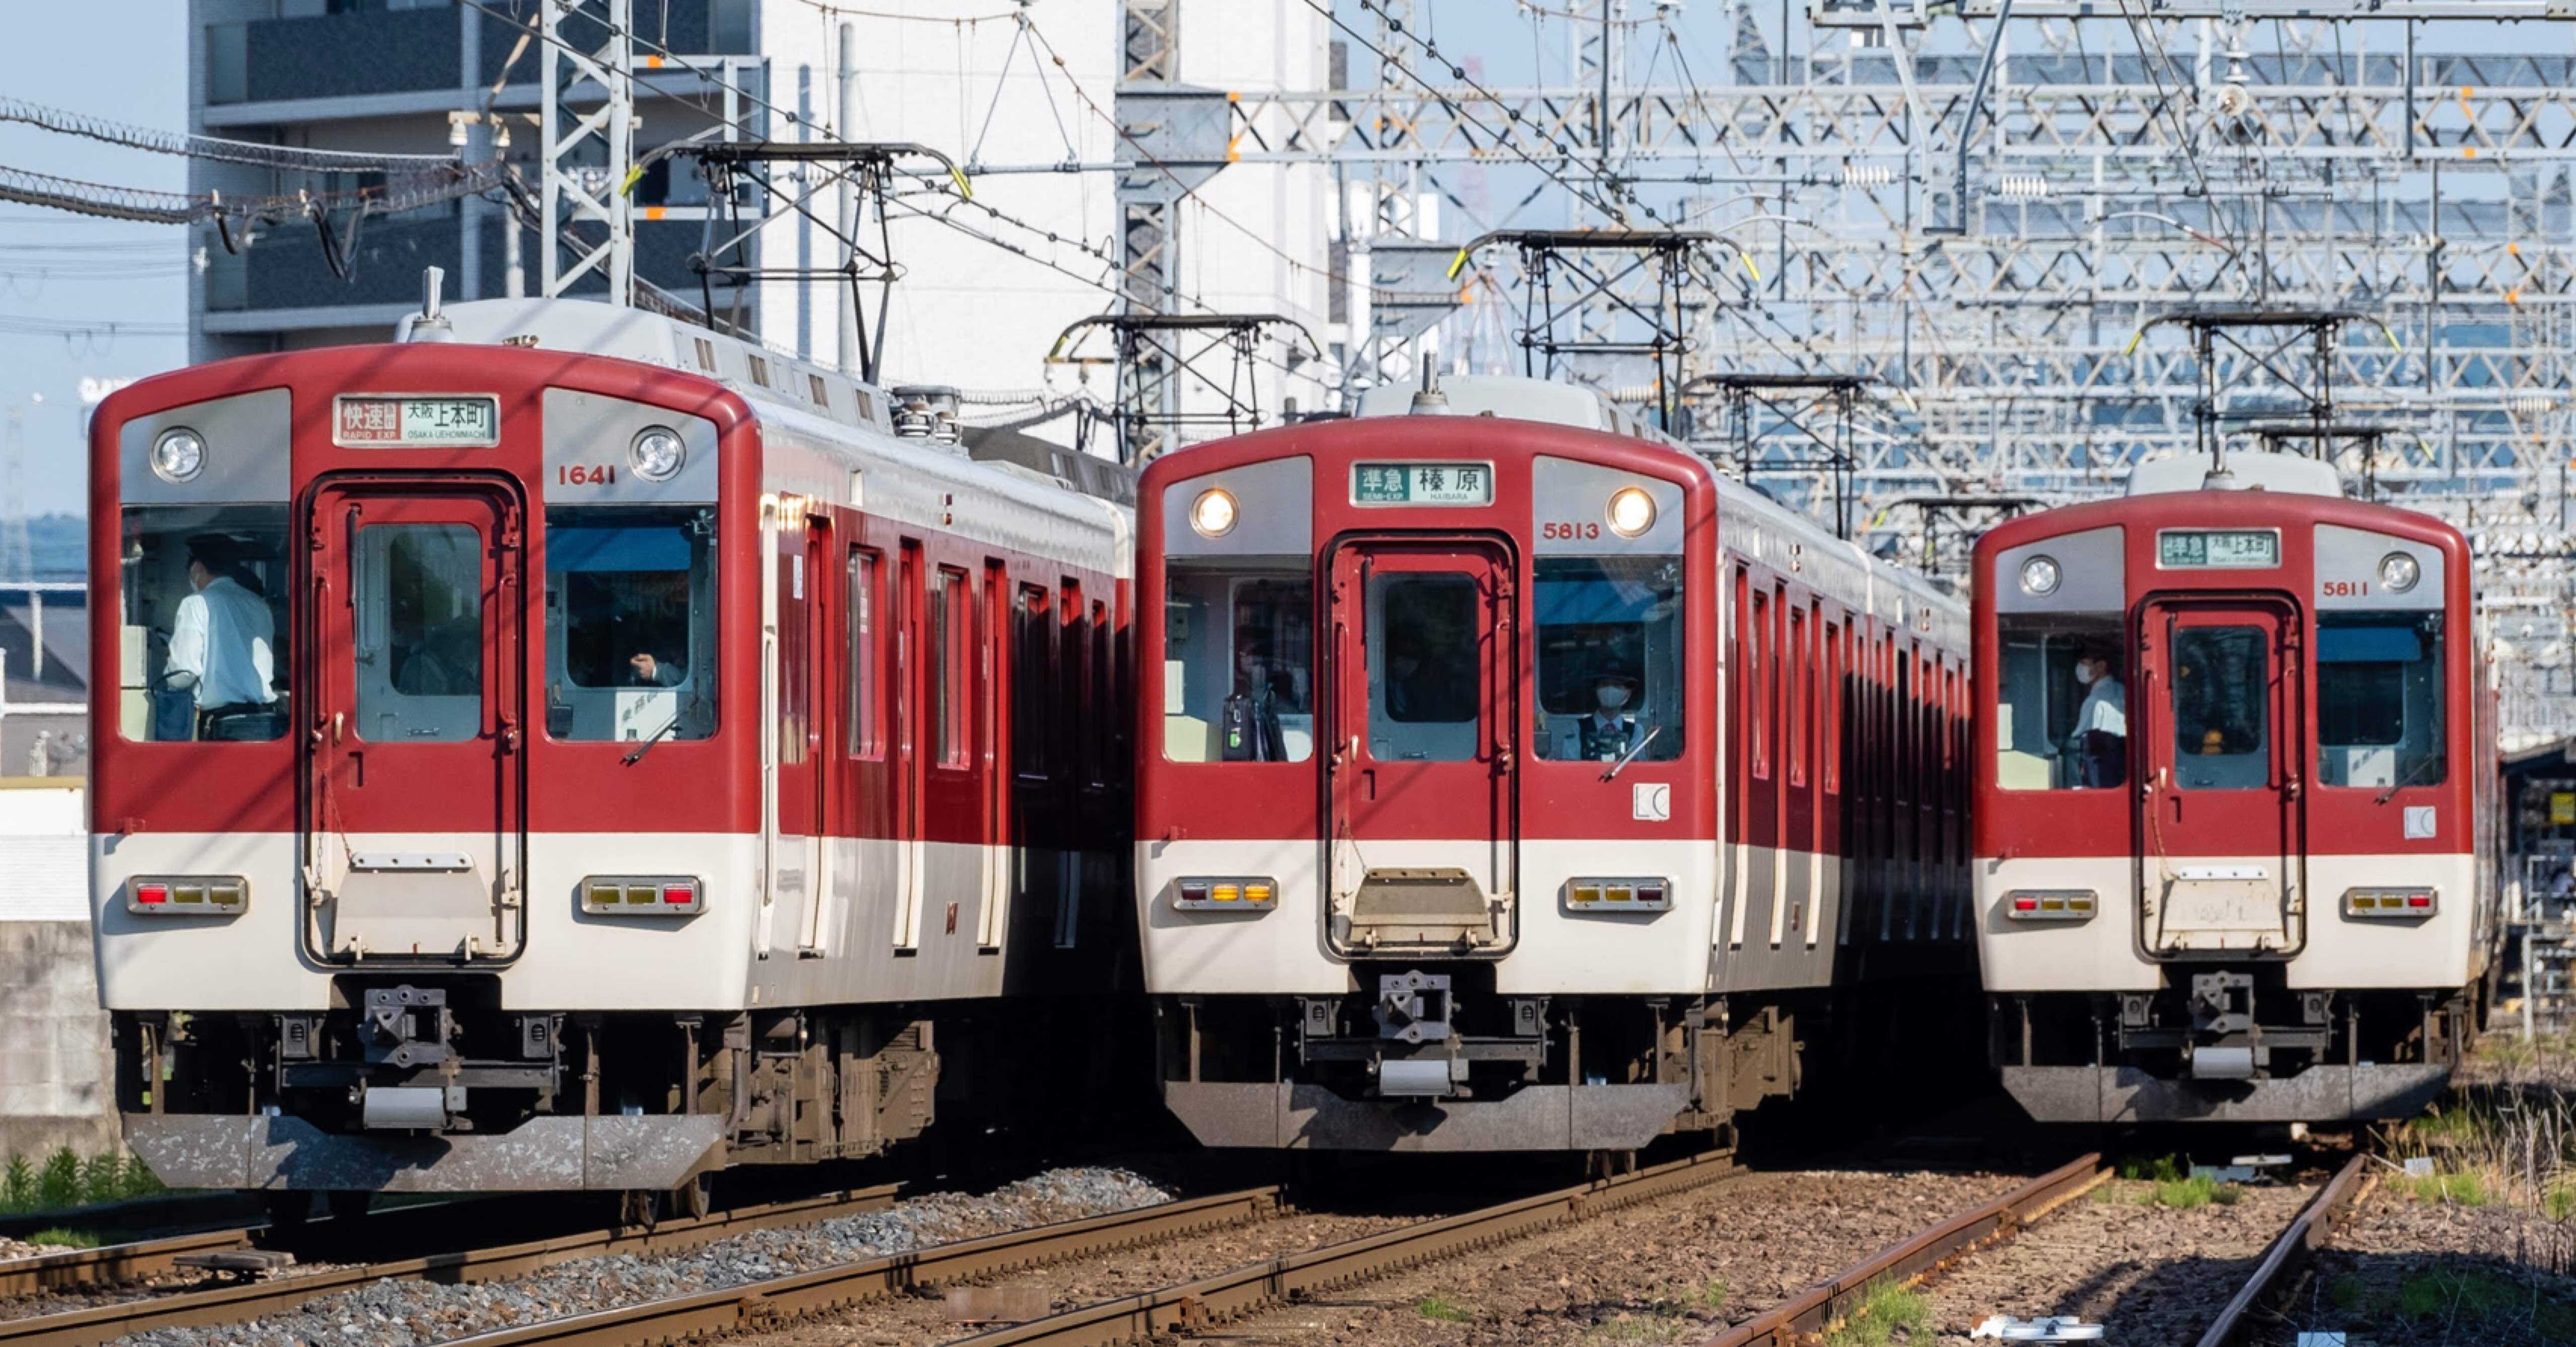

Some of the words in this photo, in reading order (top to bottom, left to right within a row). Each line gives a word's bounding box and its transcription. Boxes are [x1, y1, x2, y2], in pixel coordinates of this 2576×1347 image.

[408, 402, 486, 428] 大阪上本町
[342, 431, 372, 439] RAPID
[559, 465, 616, 485] 1641
[1362, 468, 1403, 492] 準急
[1542, 522, 1600, 540] 5813
[2323, 581, 2368, 596] 5811
[1635, 786, 1668, 817] LC
[2406, 808, 2434, 836] LC
